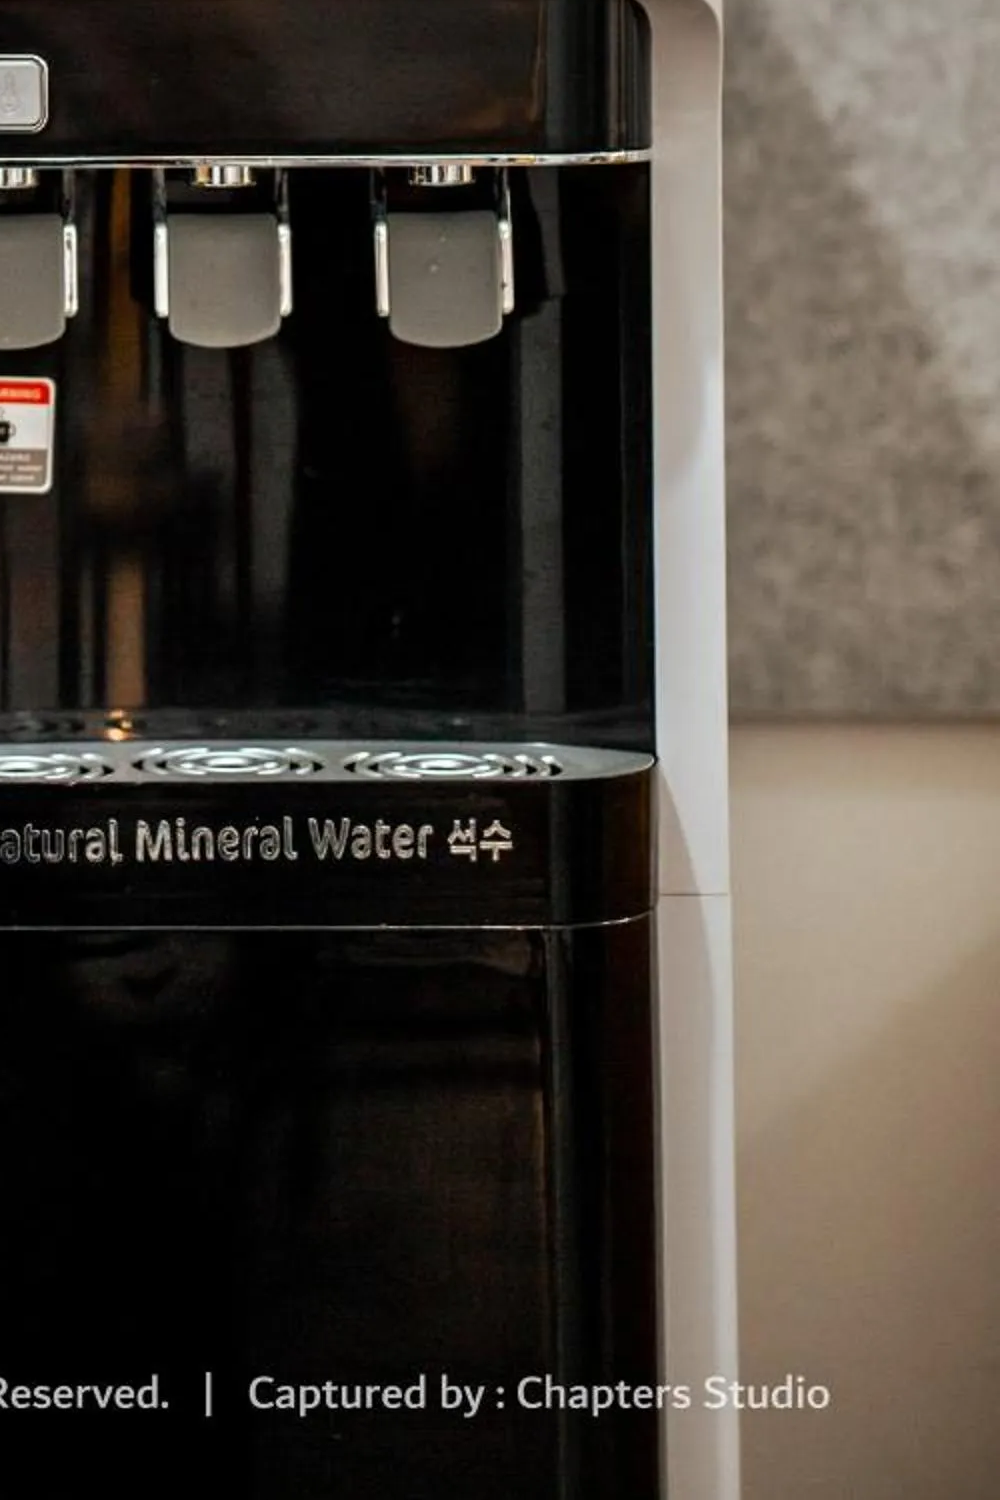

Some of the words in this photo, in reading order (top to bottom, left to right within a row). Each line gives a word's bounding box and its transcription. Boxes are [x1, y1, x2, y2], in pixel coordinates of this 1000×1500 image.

[135, 817, 299, 862] Mineral
[307, 817, 434, 861] Water
[446, 818, 515, 862] 석수
